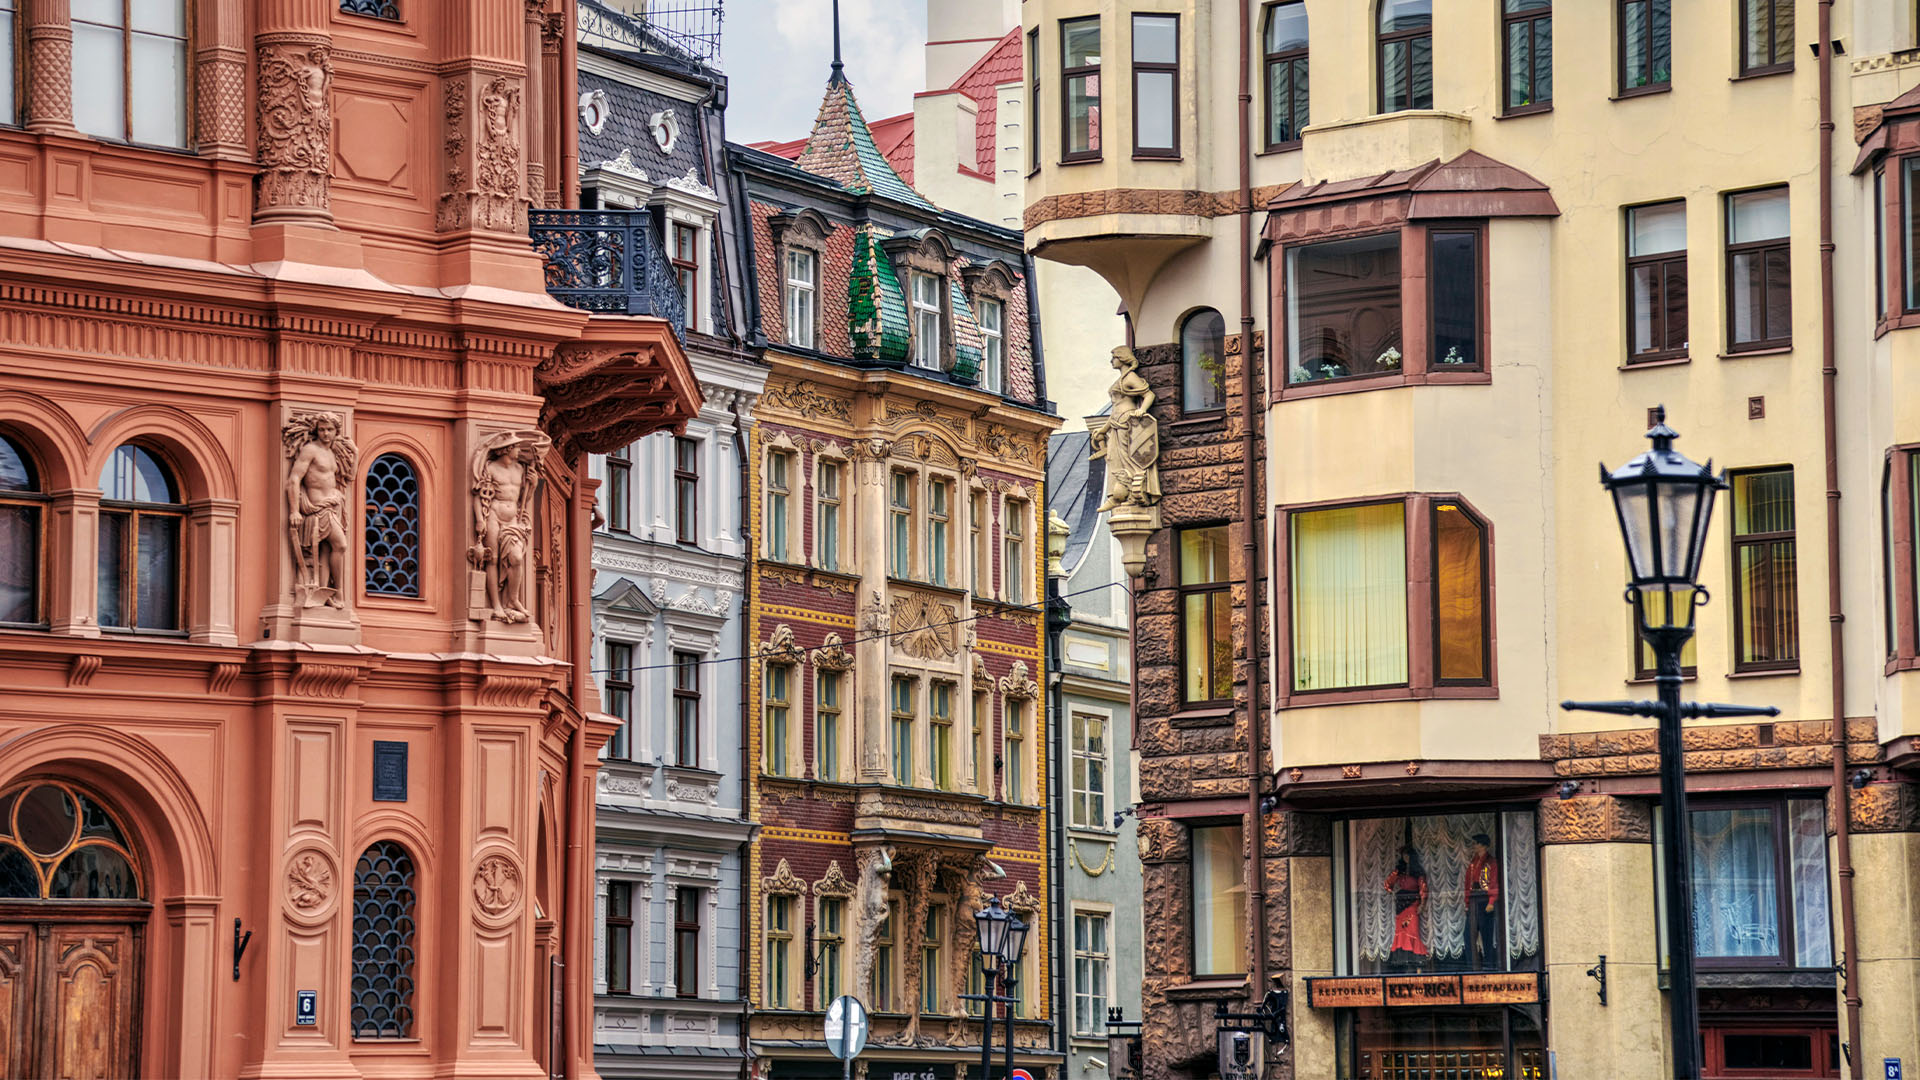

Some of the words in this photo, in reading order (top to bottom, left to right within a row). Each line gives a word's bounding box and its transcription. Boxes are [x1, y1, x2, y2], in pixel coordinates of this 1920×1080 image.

[1388, 983, 1415, 998] KEY
[1423, 982, 1458, 998] RIGA
[1468, 983, 1532, 993] RESTAURANT
[303, 998, 311, 1012] 6
